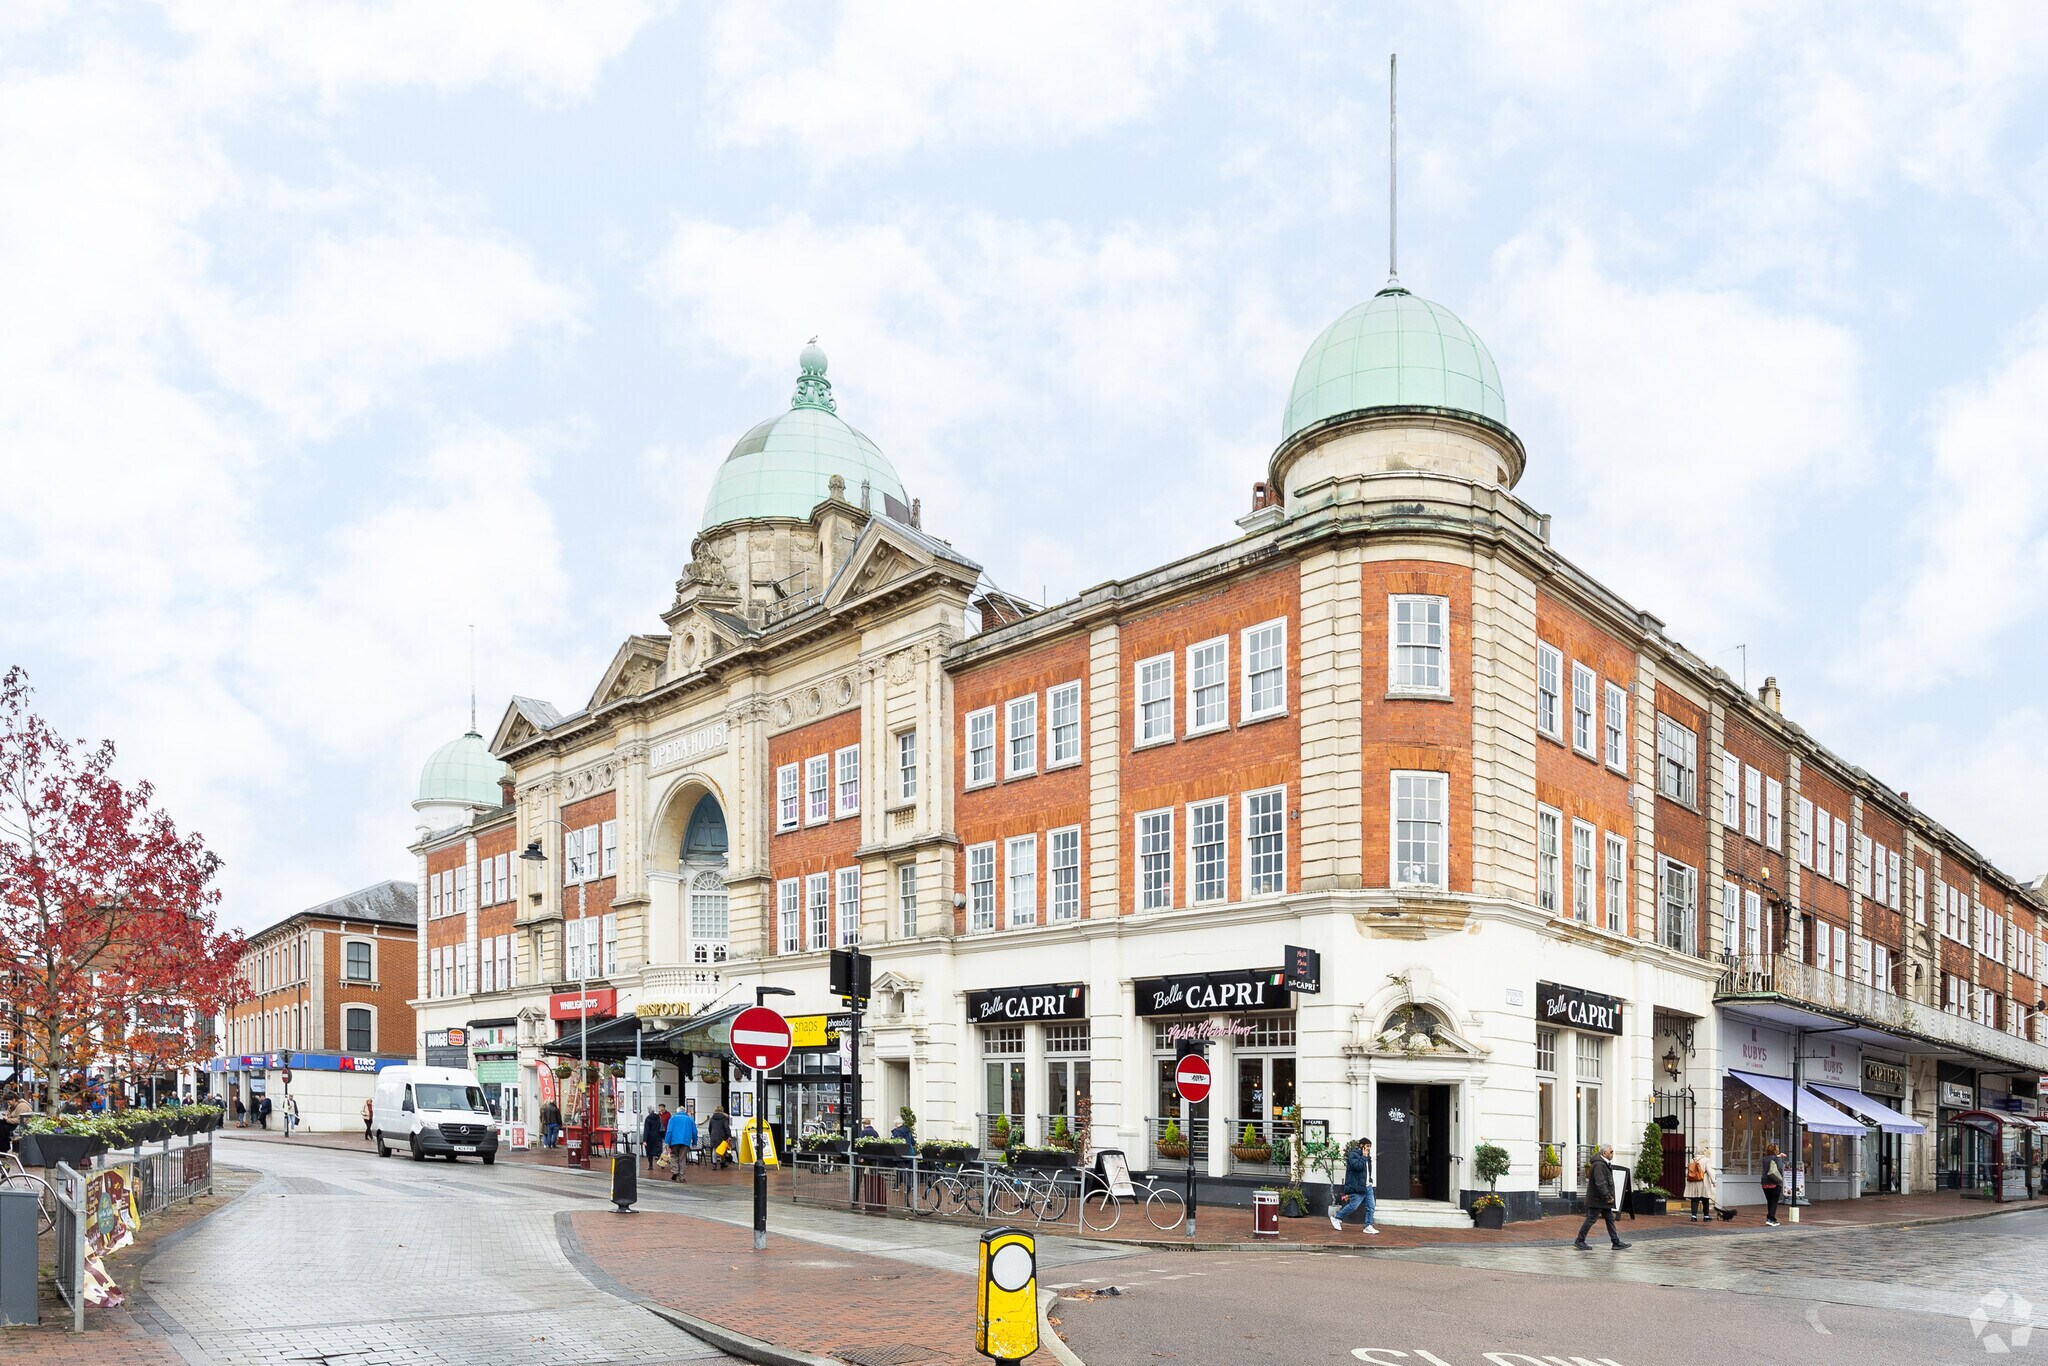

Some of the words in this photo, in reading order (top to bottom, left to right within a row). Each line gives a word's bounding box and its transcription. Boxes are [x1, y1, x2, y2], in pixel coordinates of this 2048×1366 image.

[980, 996, 1004, 1018] Bella
[1005, 995, 1066, 1018] CAPRI
[1153, 984, 1184, 1010] Bella
[1186, 982, 1266, 1009] CAPRI
[1547, 994, 1568, 1017] Bella
[1568, 1000, 1614, 1030] CAPRI
[1742, 1043, 1767, 1062] RUBYS
[339, 1056, 376, 1071] METRO
[1823, 1059, 1844, 1075] RUBYS
